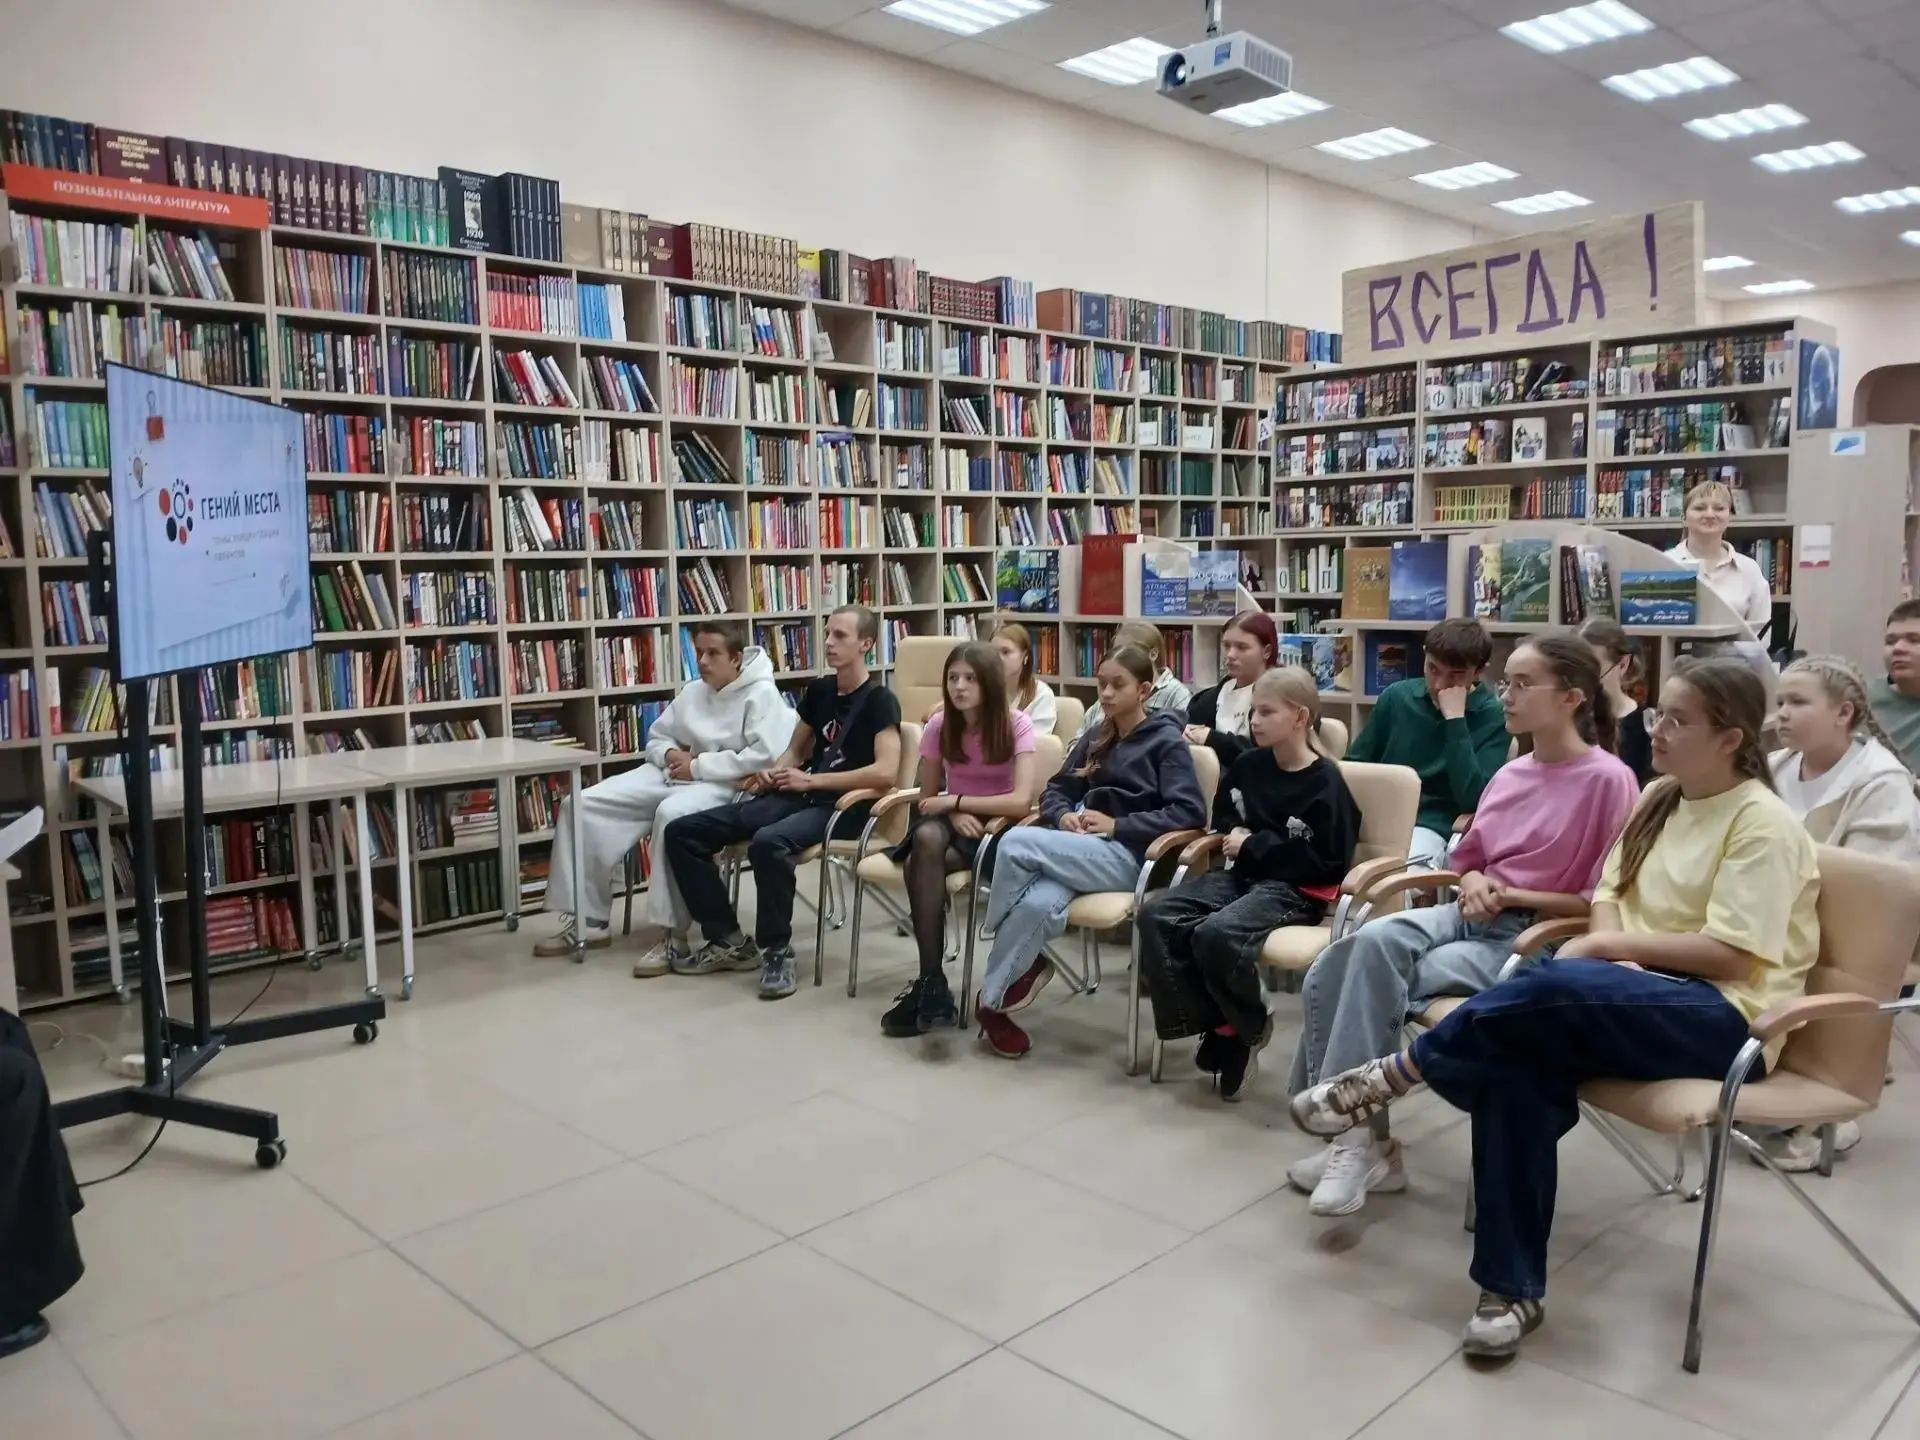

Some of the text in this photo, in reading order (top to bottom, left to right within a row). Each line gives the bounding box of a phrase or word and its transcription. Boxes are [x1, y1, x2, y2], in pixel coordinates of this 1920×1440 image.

[54, 180, 231, 215] ПОЗНАВАТЕЛЬНАЯ ЛИТЕРАТУРА
[1368, 240, 1606, 352] ВСЕГДА
[200, 490, 281, 520] ГЕНИЙ МЕСТА
[1322, 570, 1331, 589] П
